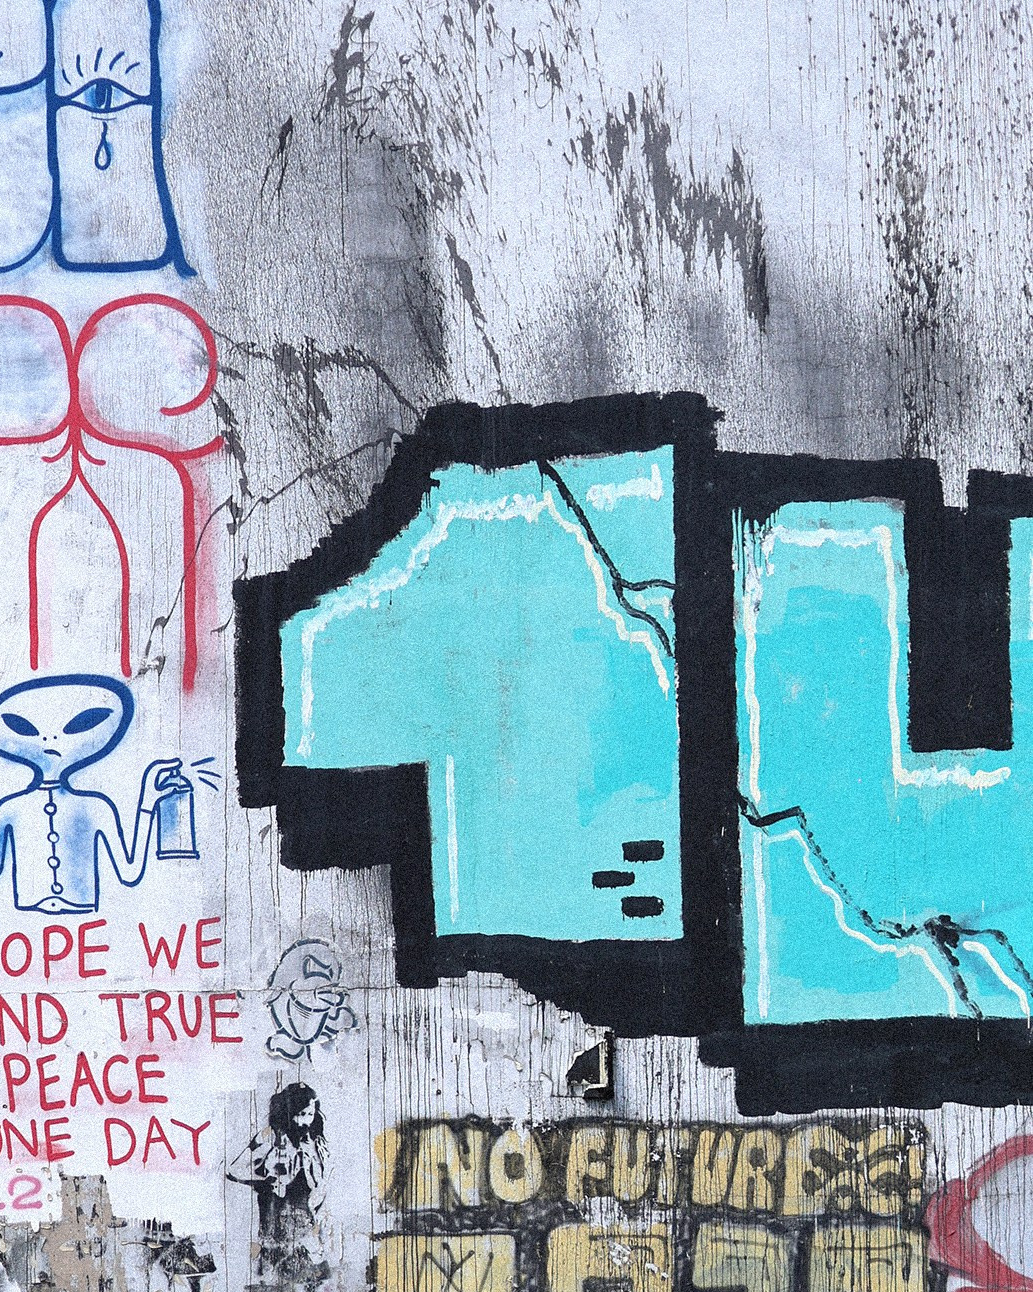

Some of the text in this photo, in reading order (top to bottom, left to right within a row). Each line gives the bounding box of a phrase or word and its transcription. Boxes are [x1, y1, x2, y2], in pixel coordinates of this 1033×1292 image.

[139, 917, 222, 972] WE
[98, 990, 244, 1044] TRUE
[3, 1052, 169, 1112] PEACE
[104, 1115, 211, 1166] DAY
